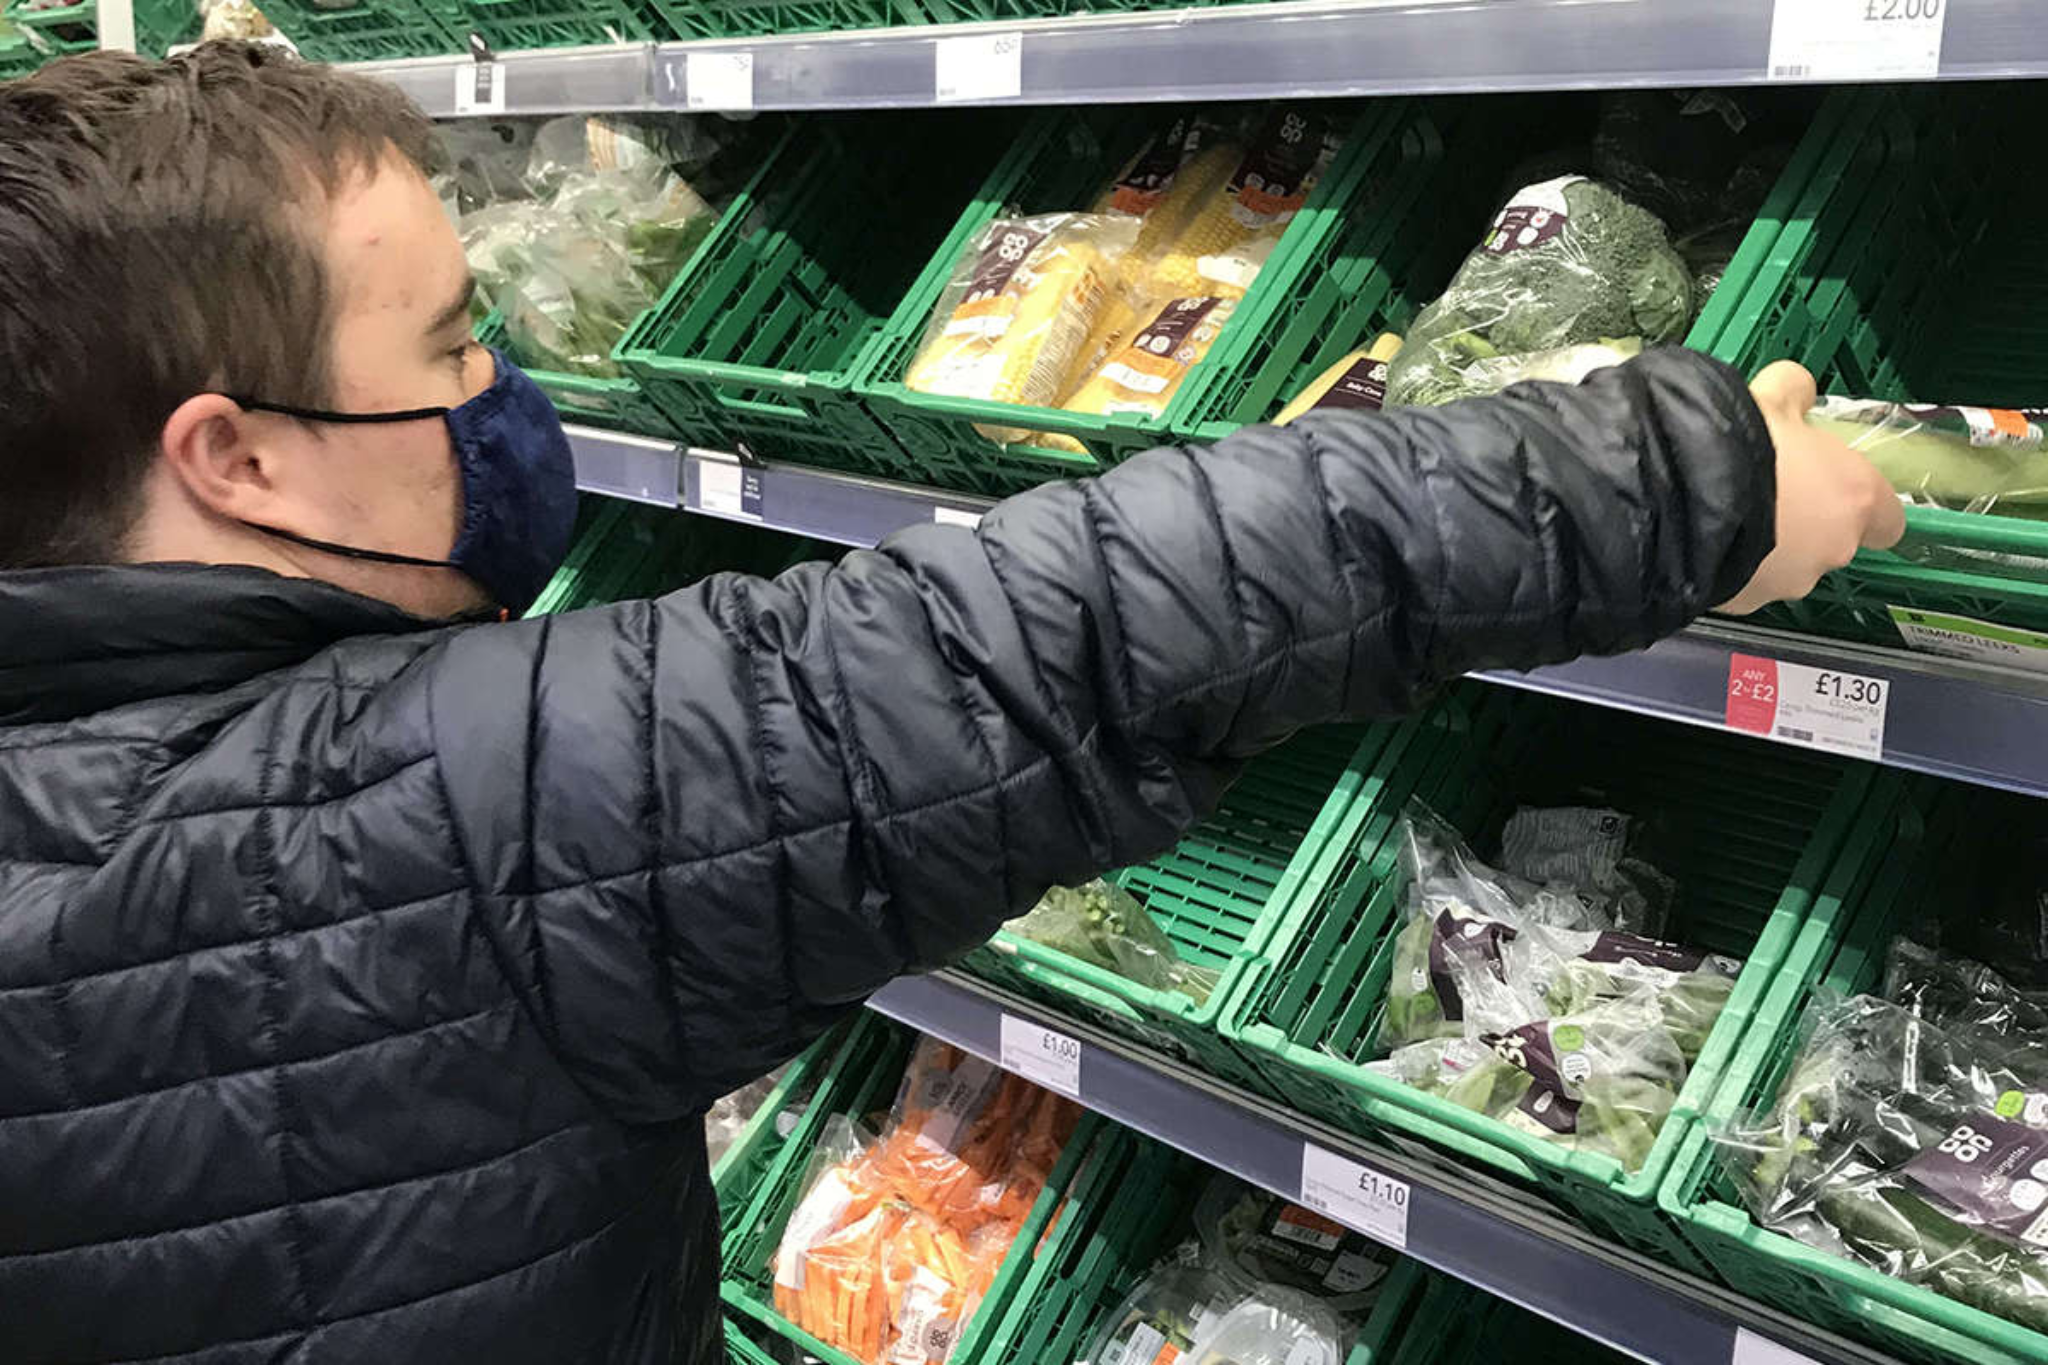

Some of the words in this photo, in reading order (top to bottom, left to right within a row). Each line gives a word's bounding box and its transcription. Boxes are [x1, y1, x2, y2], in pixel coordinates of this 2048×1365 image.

[1864, 0, 1939, 21] £2.00
[1742, 669, 1766, 681] ANY
[1731, 679, 1743, 696] 2
[1751, 683, 1775, 703] £2
[1815, 673, 1881, 705] £1.30
[1042, 1032, 1078, 1059] £1.00
[1358, 1171, 1406, 1206] £1.10
